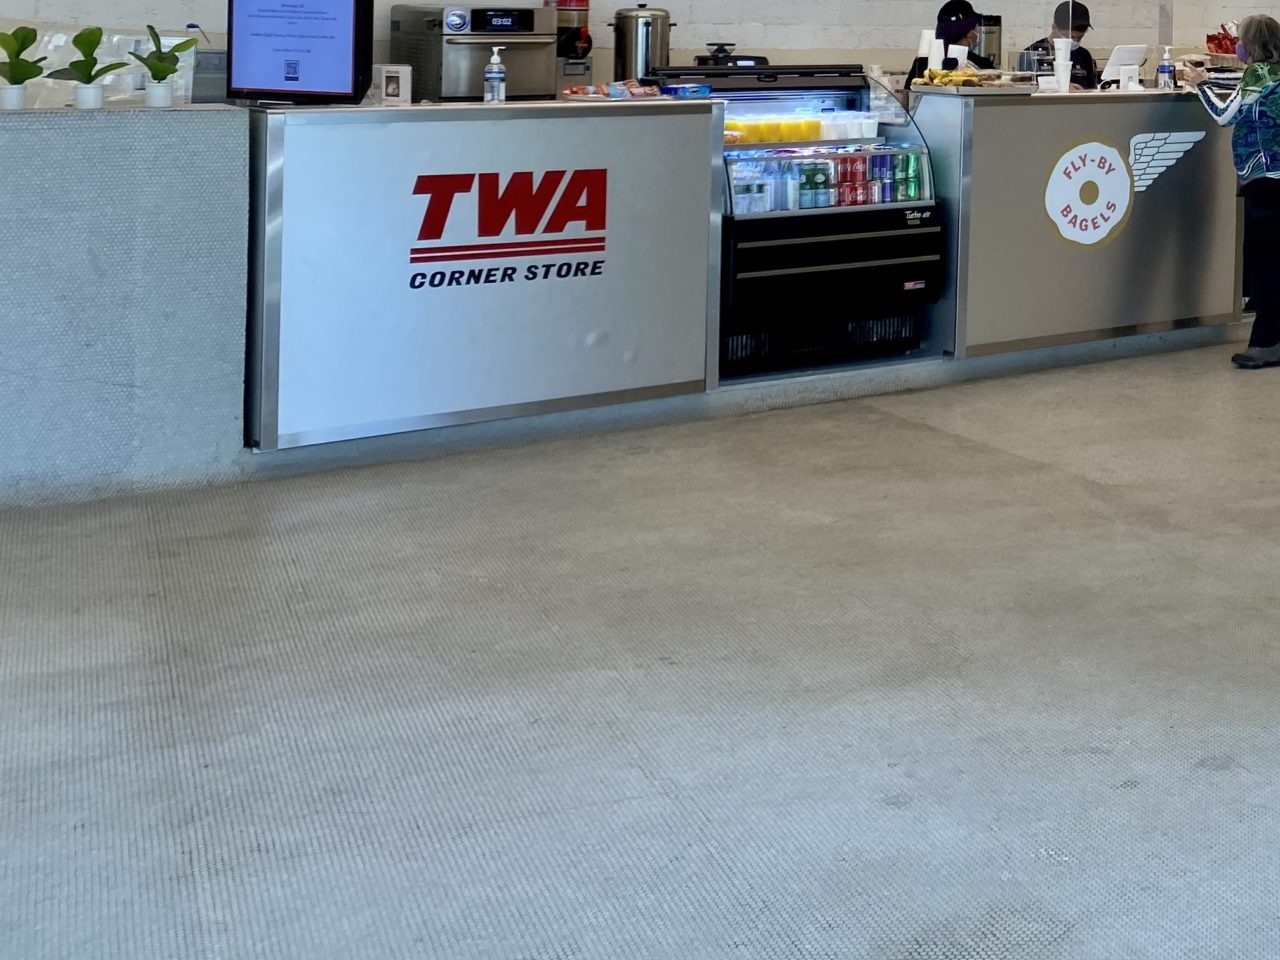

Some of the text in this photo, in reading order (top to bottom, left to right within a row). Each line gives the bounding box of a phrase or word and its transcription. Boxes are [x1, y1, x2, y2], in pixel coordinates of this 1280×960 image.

[1062, 153, 1116, 180] FLY-BY
[412, 168, 607, 241] TWA
[1060, 200, 1117, 232] BAGELS
[409, 260, 606, 289] CORNER STORE
